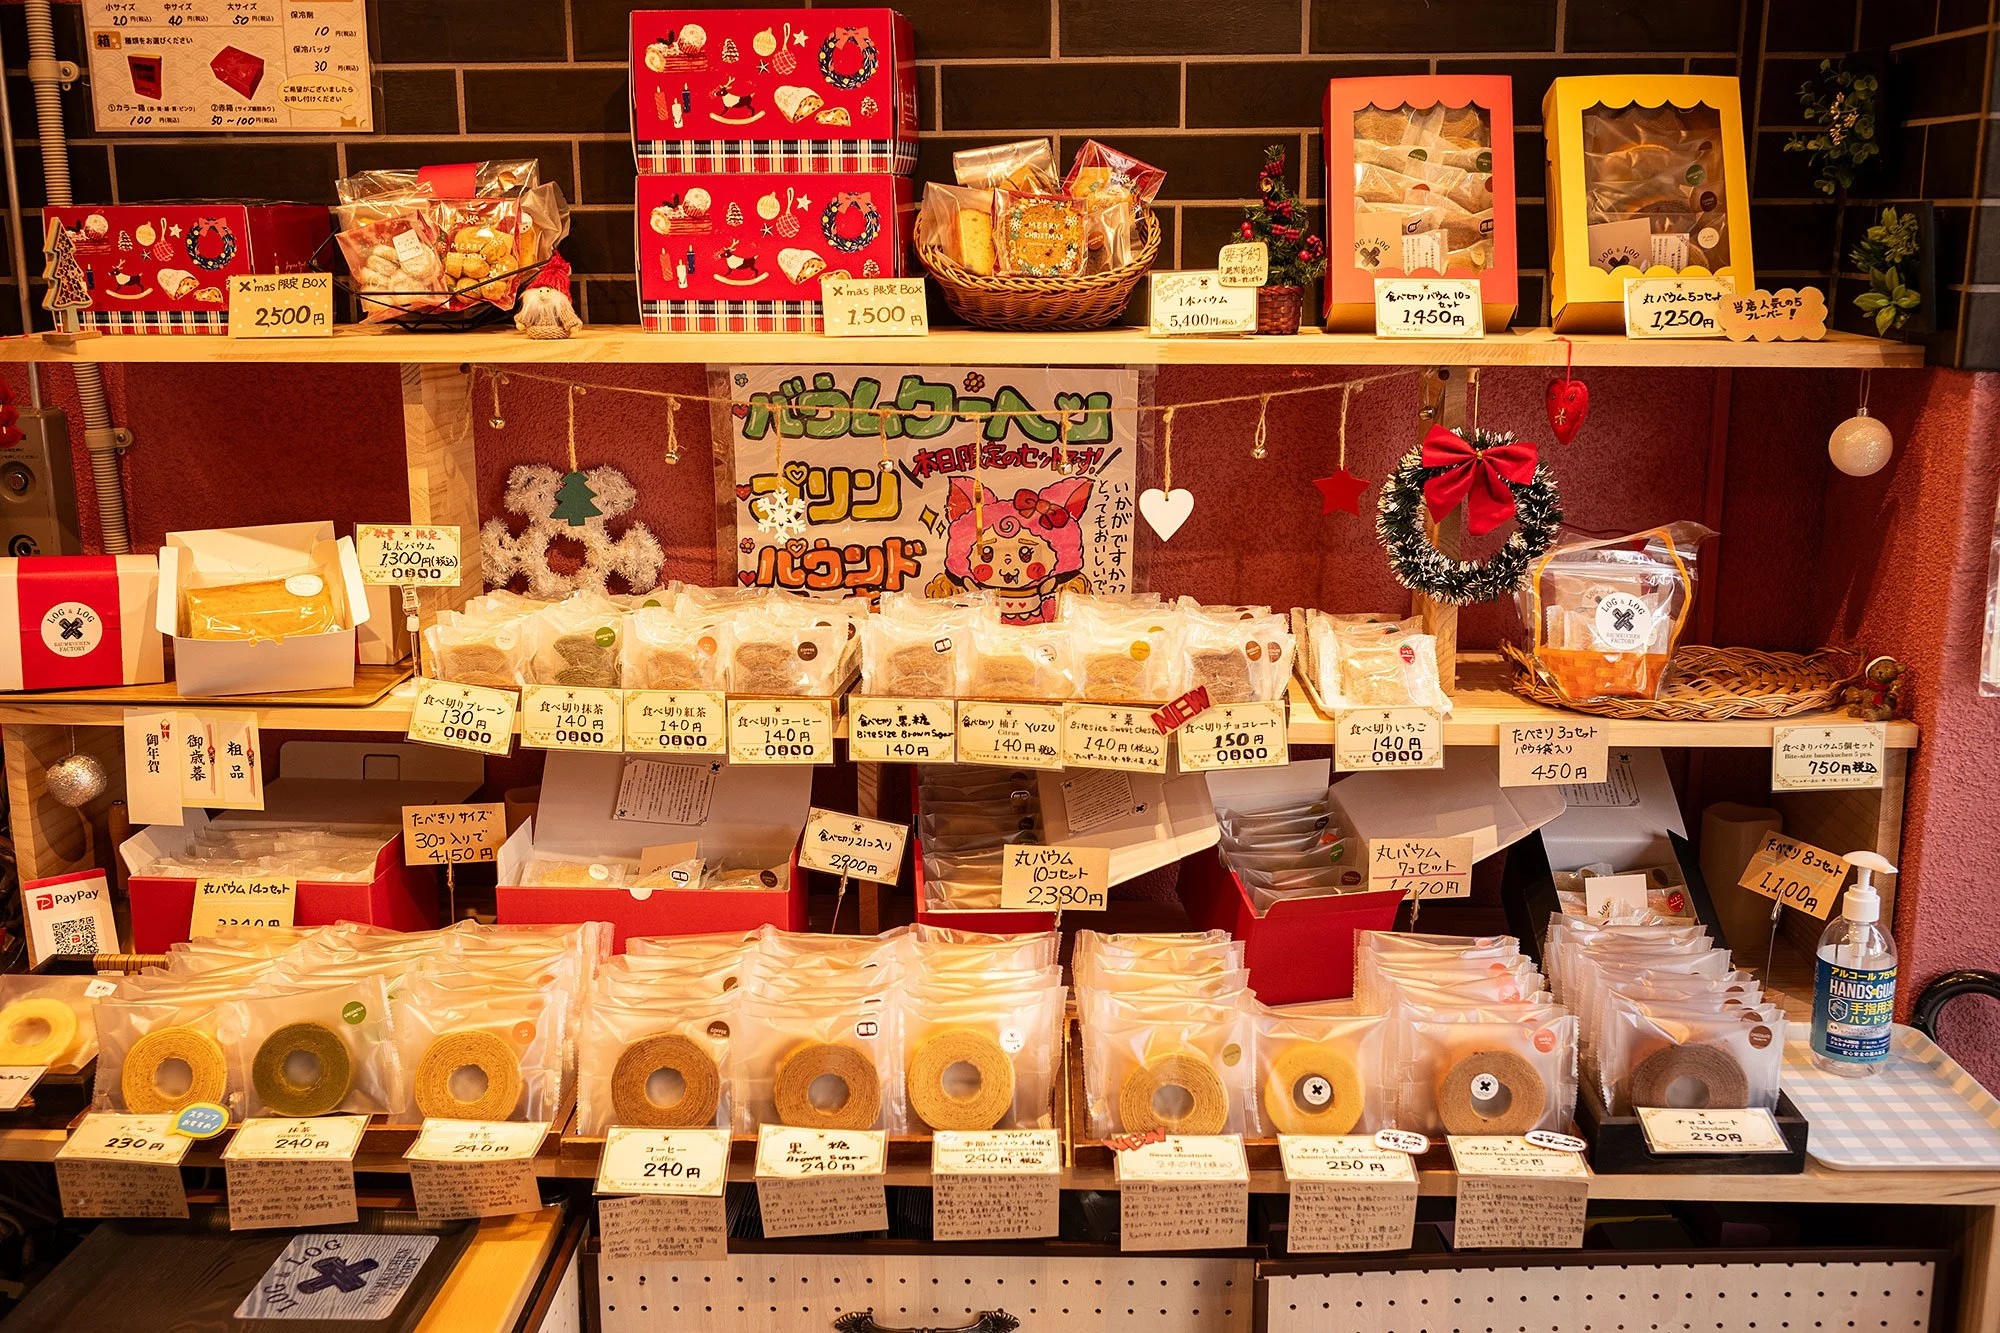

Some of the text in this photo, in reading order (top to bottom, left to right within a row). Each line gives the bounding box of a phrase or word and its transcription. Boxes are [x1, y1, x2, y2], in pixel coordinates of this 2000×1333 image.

[105, 3, 135, 11] 小サイズ
[164, 3, 192, 11] 中サイズ
[227, 3, 257, 11] 大サイズ
[97, 35, 110, 48] 箱
[292, 45, 331, 54] 保冷バッグ
[282, 85, 354, 94] ご希望がございましたら
[283, 94, 342, 103] お申し付けください
[1028, 221, 1061, 230] MERRY
[1024, 231, 1064, 241] CHRISTMAS
[1374, 237, 1391, 251] LOG
[1598, 248, 1614, 264] LOG
[1623, 246, 1640, 260] LOG
[277, 276, 299, 291] 限定
[301, 278, 327, 289] BOX
[873, 284, 898, 296] 限定
[1179, 296, 1228, 307] 1本バウム
[1438, 301, 1460, 309] セット
[1402, 309, 1465, 326] 1,450円
[1650, 310, 1714, 331] 1,250円
[742, 372, 1113, 444] バウムクーヘン
[416, 528, 441, 540] 限定
[382, 541, 435, 551] 丸太バウム
[380, 552, 458, 568] 1,300円(税込)
[756, 536, 927, 592] パウンド
[1602, 597, 1645, 616] LOG LOG
[47, 607, 95, 624] LOG LOG
[424, 694, 505, 715] 食べ切りプレーン
[540, 701, 603, 715] 食べ切り抹茶
[642, 705, 706, 718] 食べ切り紅茶
[1151, 685, 1211, 736] NEW
[440, 709, 487, 730] 130円
[556, 714, 604, 730] 140円
[660, 719, 702, 732] 140円
[738, 716, 822, 728] 食べ切りコーヒー
[1123, 713, 1134, 726] 栗
[1185, 719, 1277, 734] 食べ切りチョコレート
[1025, 722, 1056, 733] YUZU
[1109, 724, 1134, 735] Sweet
[1350, 722, 1427, 735] 食べ切りいちご
[764, 728, 810, 744] 140円
[901, 731, 931, 739] Brown
[1212, 732, 1264, 749] 150円
[886, 744, 929, 757] 140円
[1373, 736, 1421, 751] 140円
[1782, 741, 1875, 752] 食べきりバウム5個セット
[146, 733, 160, 774] 御年賀
[187, 735, 206, 782] 御歳暮
[227, 741, 244, 779] 粗品
[1531, 763, 1587, 780] 450円
[1015, 850, 1073, 867] 丸バウム
[1376, 843, 1441, 862] 丸バウム
[1033, 867, 1088, 882] 10コセット
[1399, 860, 1456, 876] 7コセット
[55, 888, 100, 905] PayPay
[1027, 886, 1103, 907] 2,380円
[1759, 871, 1818, 912] 1,100円
[1831, 967, 1876, 981] アルコール
[1830, 979, 1873, 999] HANDS
[188, 1109, 219, 1121] スタッフ
[105, 1137, 165, 1151] 230円
[275, 1138, 330, 1150] 240円
[1102, 1126, 1166, 1152] NEW
[1691, 1132, 1743, 1142] 250円
[453, 1144, 509, 1154] 240円
[645, 1146, 687, 1154] コーヒー
[800, 1160, 855, 1174] 240円
[1326, 1160, 1385, 1172] 250円
[1497, 1158, 1544, 1166] 250円
[643, 1162, 700, 1179] 240円
[285, 1239, 342, 1267] LOG
